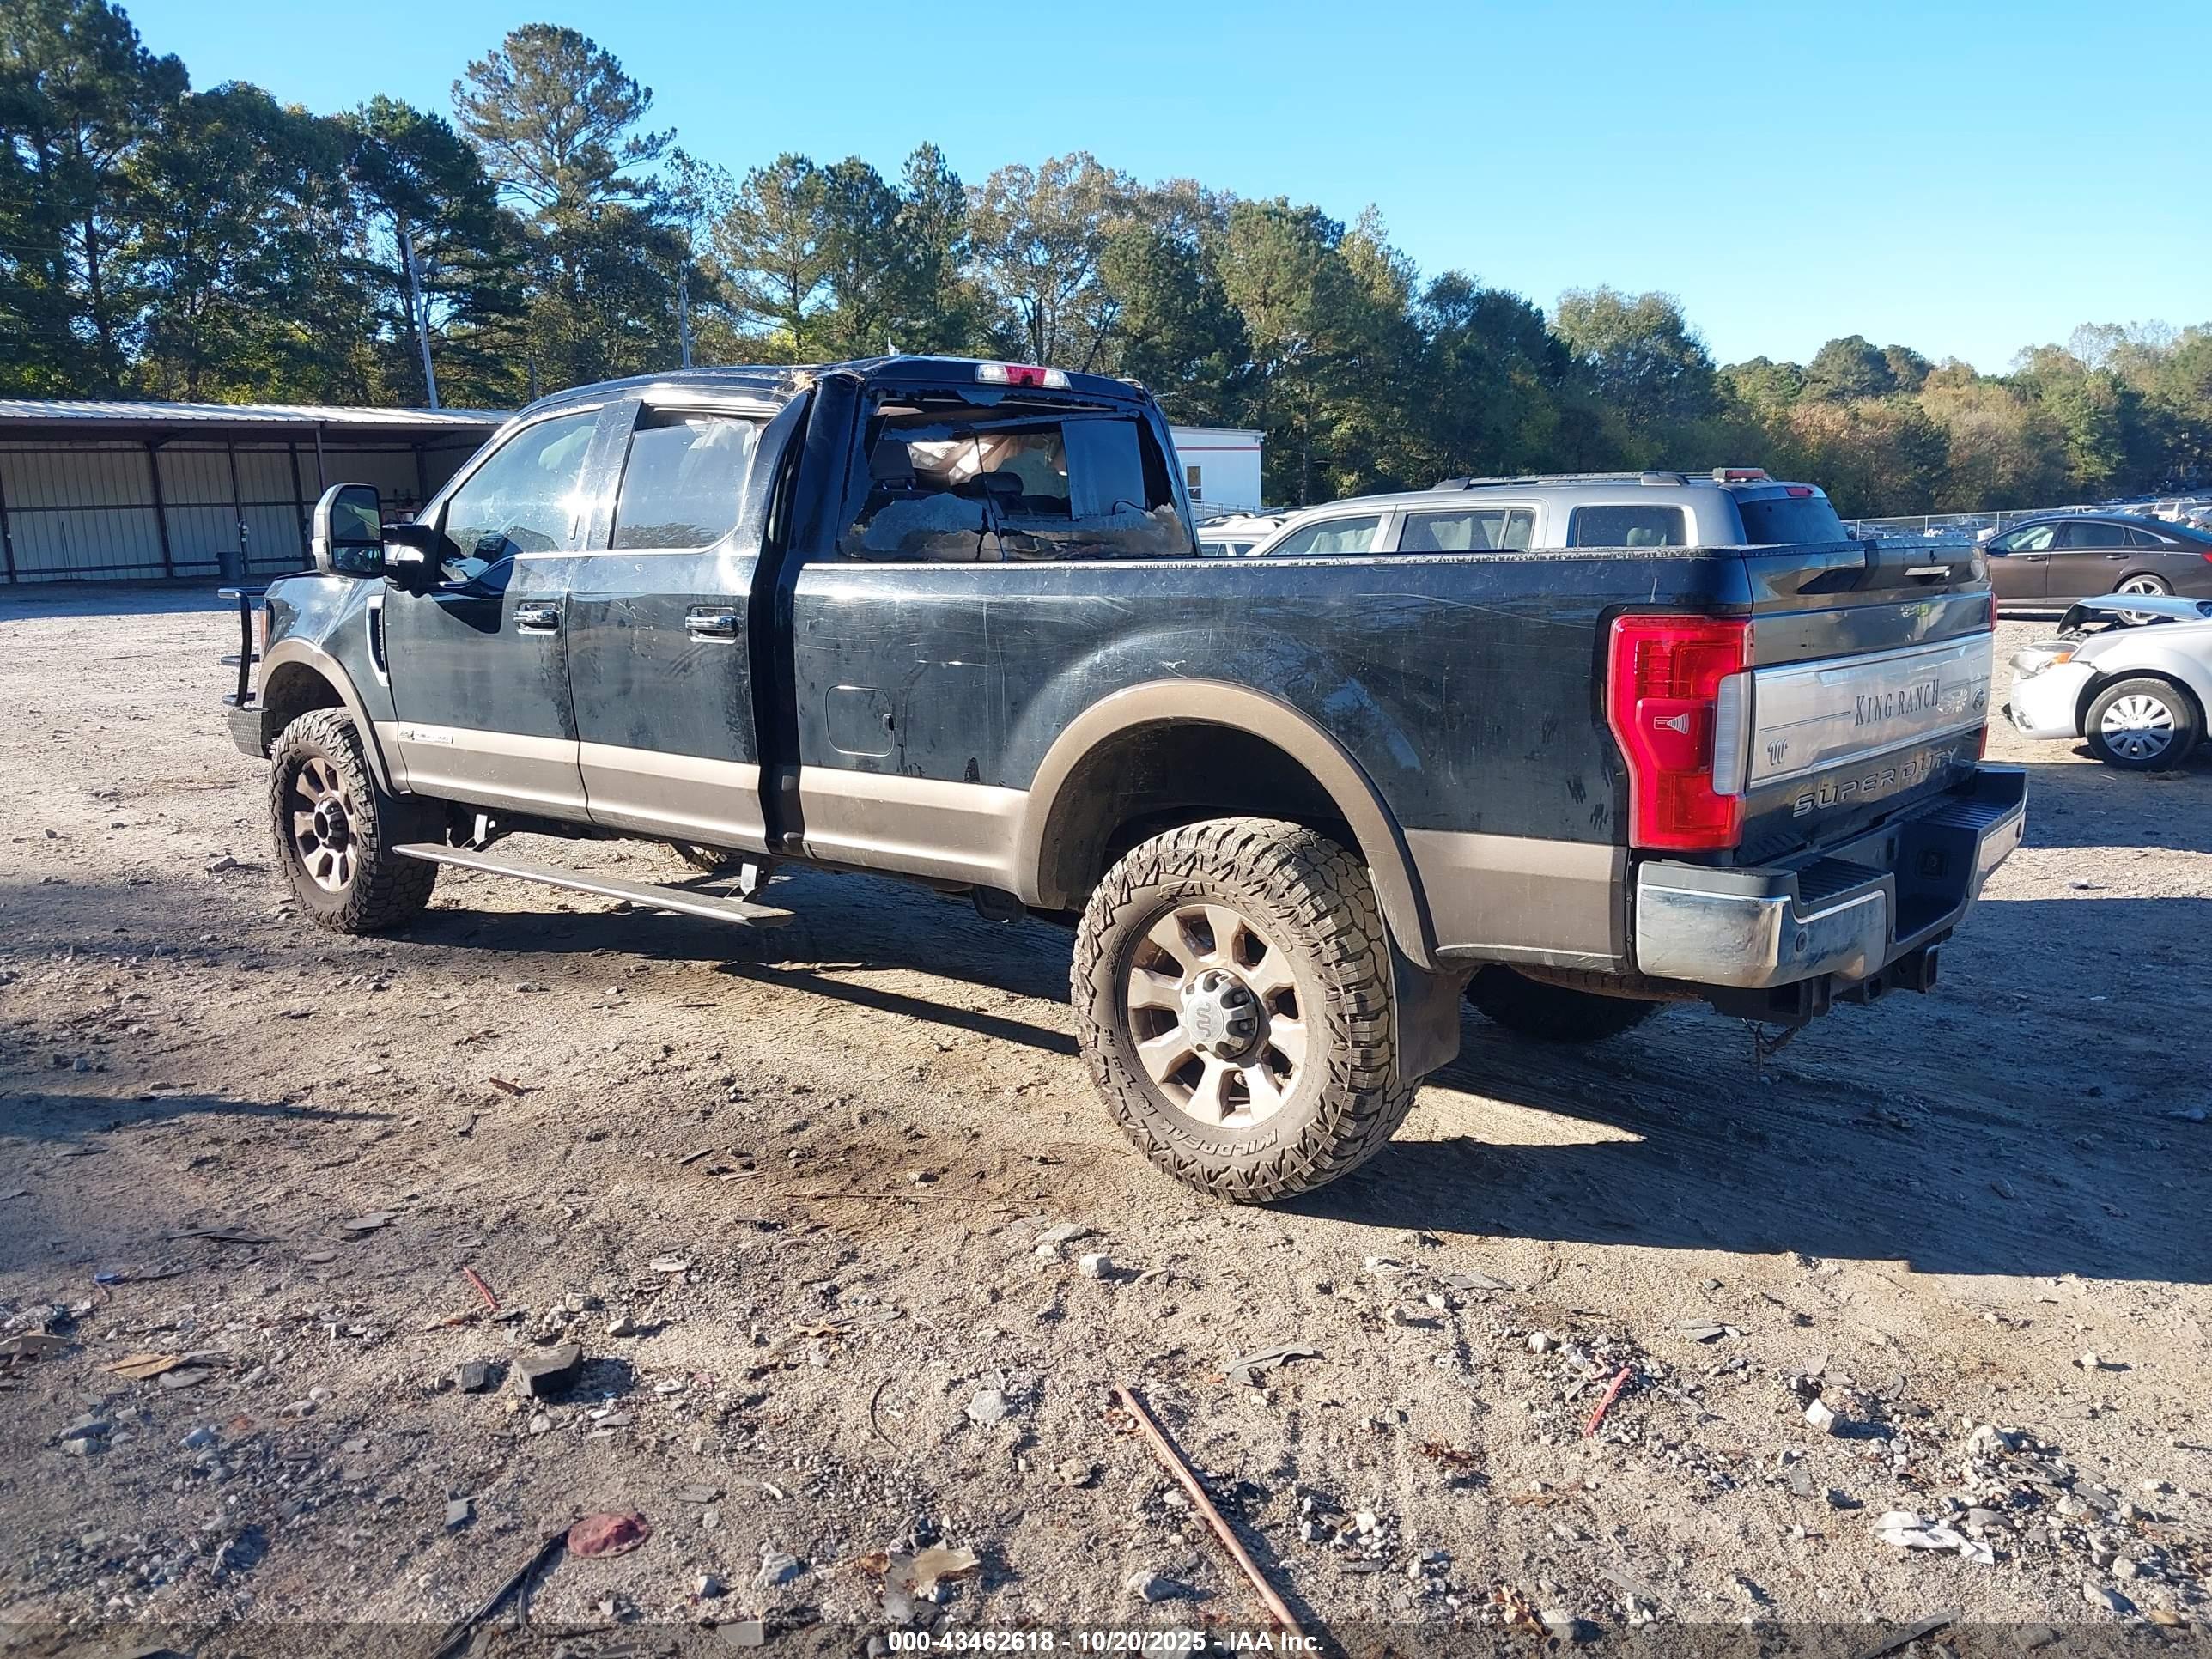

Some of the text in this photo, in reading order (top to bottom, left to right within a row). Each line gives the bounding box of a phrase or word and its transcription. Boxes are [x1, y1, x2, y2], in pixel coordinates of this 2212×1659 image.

[1855, 678, 1940, 726] KING RANCH
[1792, 747, 1958, 817] SUPER DUTY
[1157, 1115, 1279, 1158] WILDPEAK
